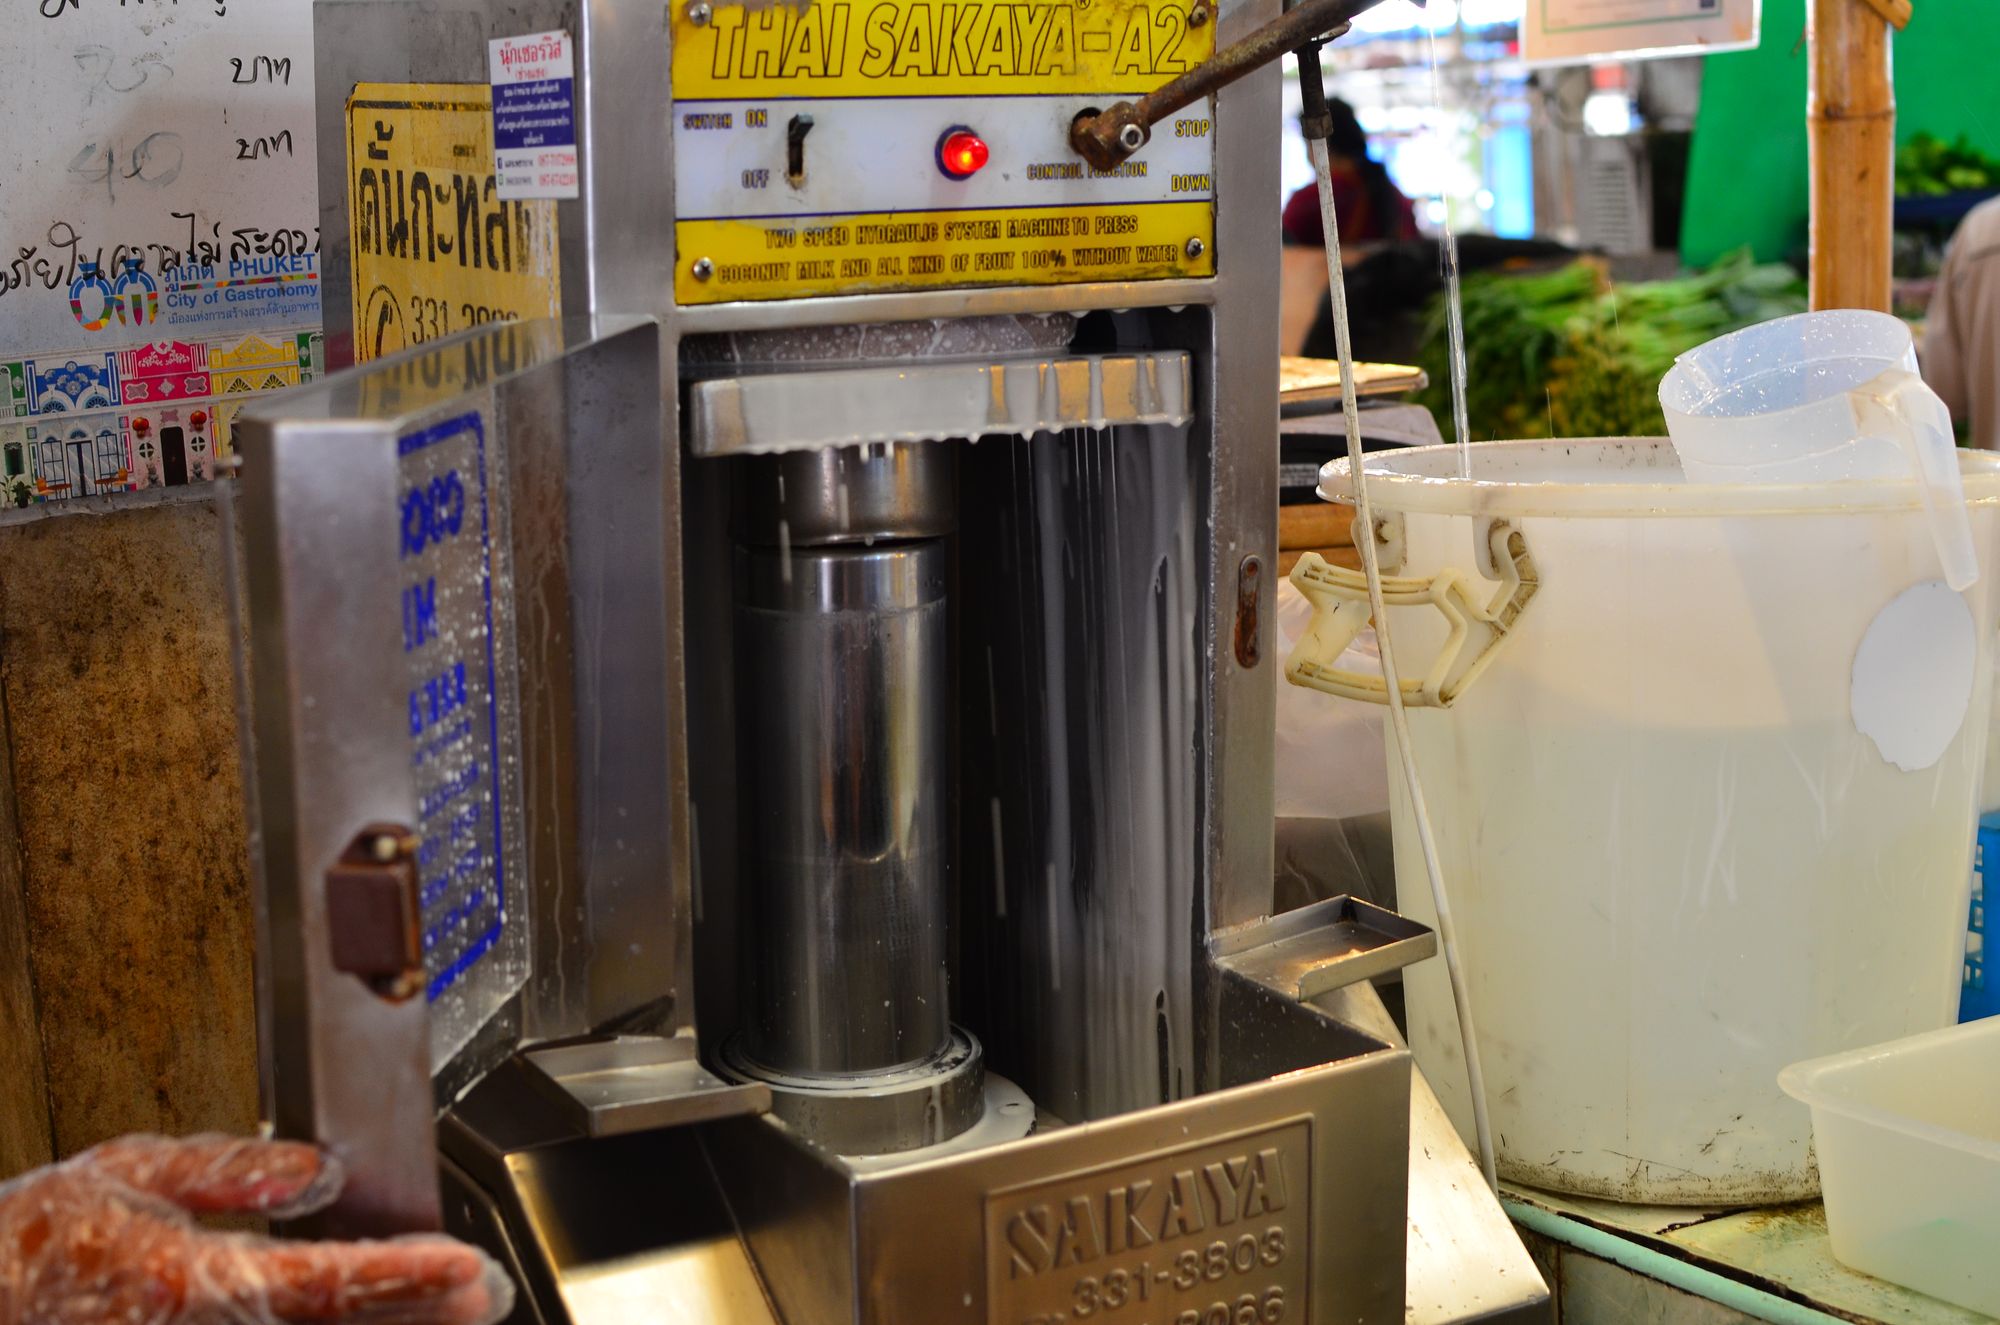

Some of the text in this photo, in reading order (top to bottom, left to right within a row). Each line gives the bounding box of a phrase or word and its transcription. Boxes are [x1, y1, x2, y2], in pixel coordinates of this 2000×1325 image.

[710, 3, 850, 79] THAI
[229, 55, 291, 86] บาท
[683, 108, 768, 130] SWITCH ON
[1174, 119, 1210, 137] STOP
[236, 130, 293, 160] บาท
[741, 168, 770, 189] OFF
[1027, 162, 1083, 181] CONTROL
[1171, 173, 1210, 192] DOWN
[765, 215, 1138, 248] TWO SPEED HYDRAULIC SYSTEM MACHINE TO PRESS
[229, 253, 315, 278] PHUKET
[717, 244, 1179, 283] COCONUT MILK AND ALL KIND OF FRUIT 100% WITHOUT WATER
[166, 284, 319, 309] City of Gastronomy
[1006, 1148, 1287, 1280] SAKAYA
[1072, 1226, 1286, 1317] 331-3803
